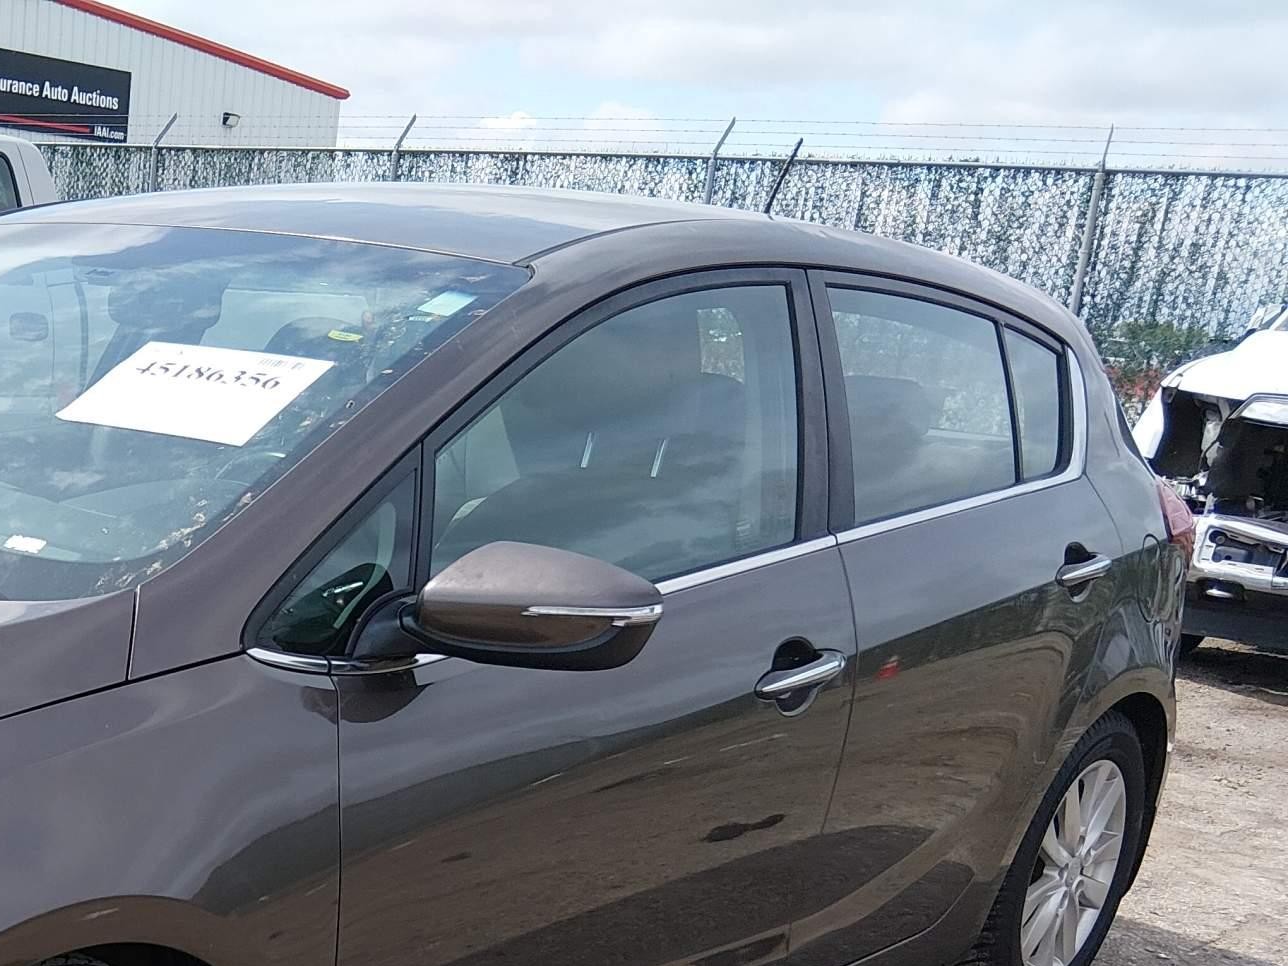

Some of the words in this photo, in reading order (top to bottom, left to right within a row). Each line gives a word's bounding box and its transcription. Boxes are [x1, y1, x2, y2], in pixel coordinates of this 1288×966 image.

[42, 81, 69, 101] Auto
[71, 86, 119, 110] Auctions
[94, 125, 125, 140] IAAI.com
[135, 360, 281, 390] 45186356
